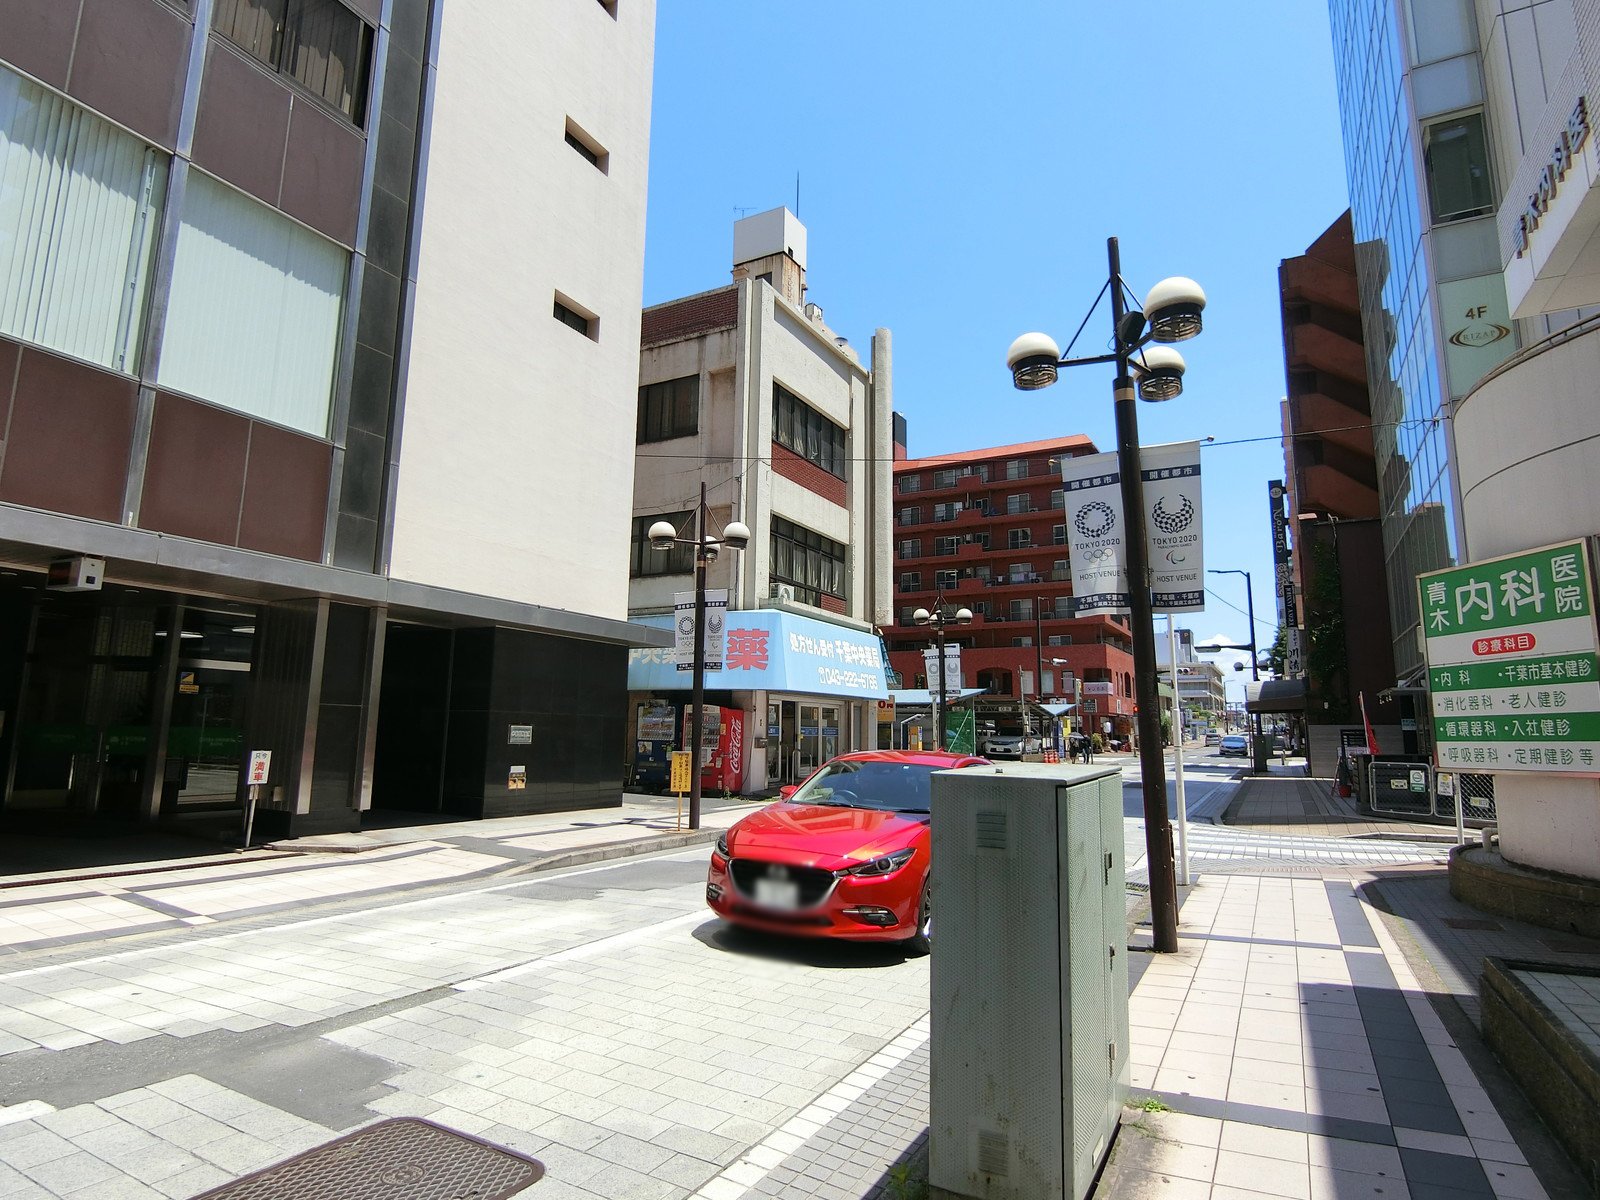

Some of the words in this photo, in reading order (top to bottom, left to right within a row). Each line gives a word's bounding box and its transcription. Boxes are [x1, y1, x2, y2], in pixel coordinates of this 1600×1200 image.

[1465, 305, 1487, 320] 4F
[1463, 330, 1495, 341] RIZAP
[1149, 466, 1193, 479] 開催都市
[1071, 476, 1112, 490] 開催都市
[1075, 539, 1100, 551] TOKYO
[1101, 537, 1121, 547] 2020
[1152, 536, 1178, 546] TOKYO
[1178, 534, 1198, 543] 2020
[1079, 572, 1096, 581] HOST
[1097, 569, 1121, 578] VENUE
[1156, 575, 1174, 583] HOST
[1175, 572, 1197, 582] VENUE
[1426, 581, 1450, 632] 青木
[1455, 566, 1546, 625] 内科
[1551, 553, 1583, 614] 医院
[726, 628, 770, 671] 薬
[790, 631, 835, 659] 処方せん受付
[834, 639, 881, 669] 千葉中央薬局
[1477, 635, 1530, 654] 診療科目
[1440, 670, 1471, 687] 内科
[1504, 659, 1591, 683] 千葉市基本健診
[1443, 694, 1494, 712] 消化器科
[1508, 690, 1567, 709] 老人健診
[1445, 720, 1497, 738] 循環器科
[1511, 719, 1571, 737] 入社健診
[1448, 747, 1499, 764] 呼吸器科
[1514, 747, 1574, 765] 定期健診
[253, 761, 266, 782] 満車
